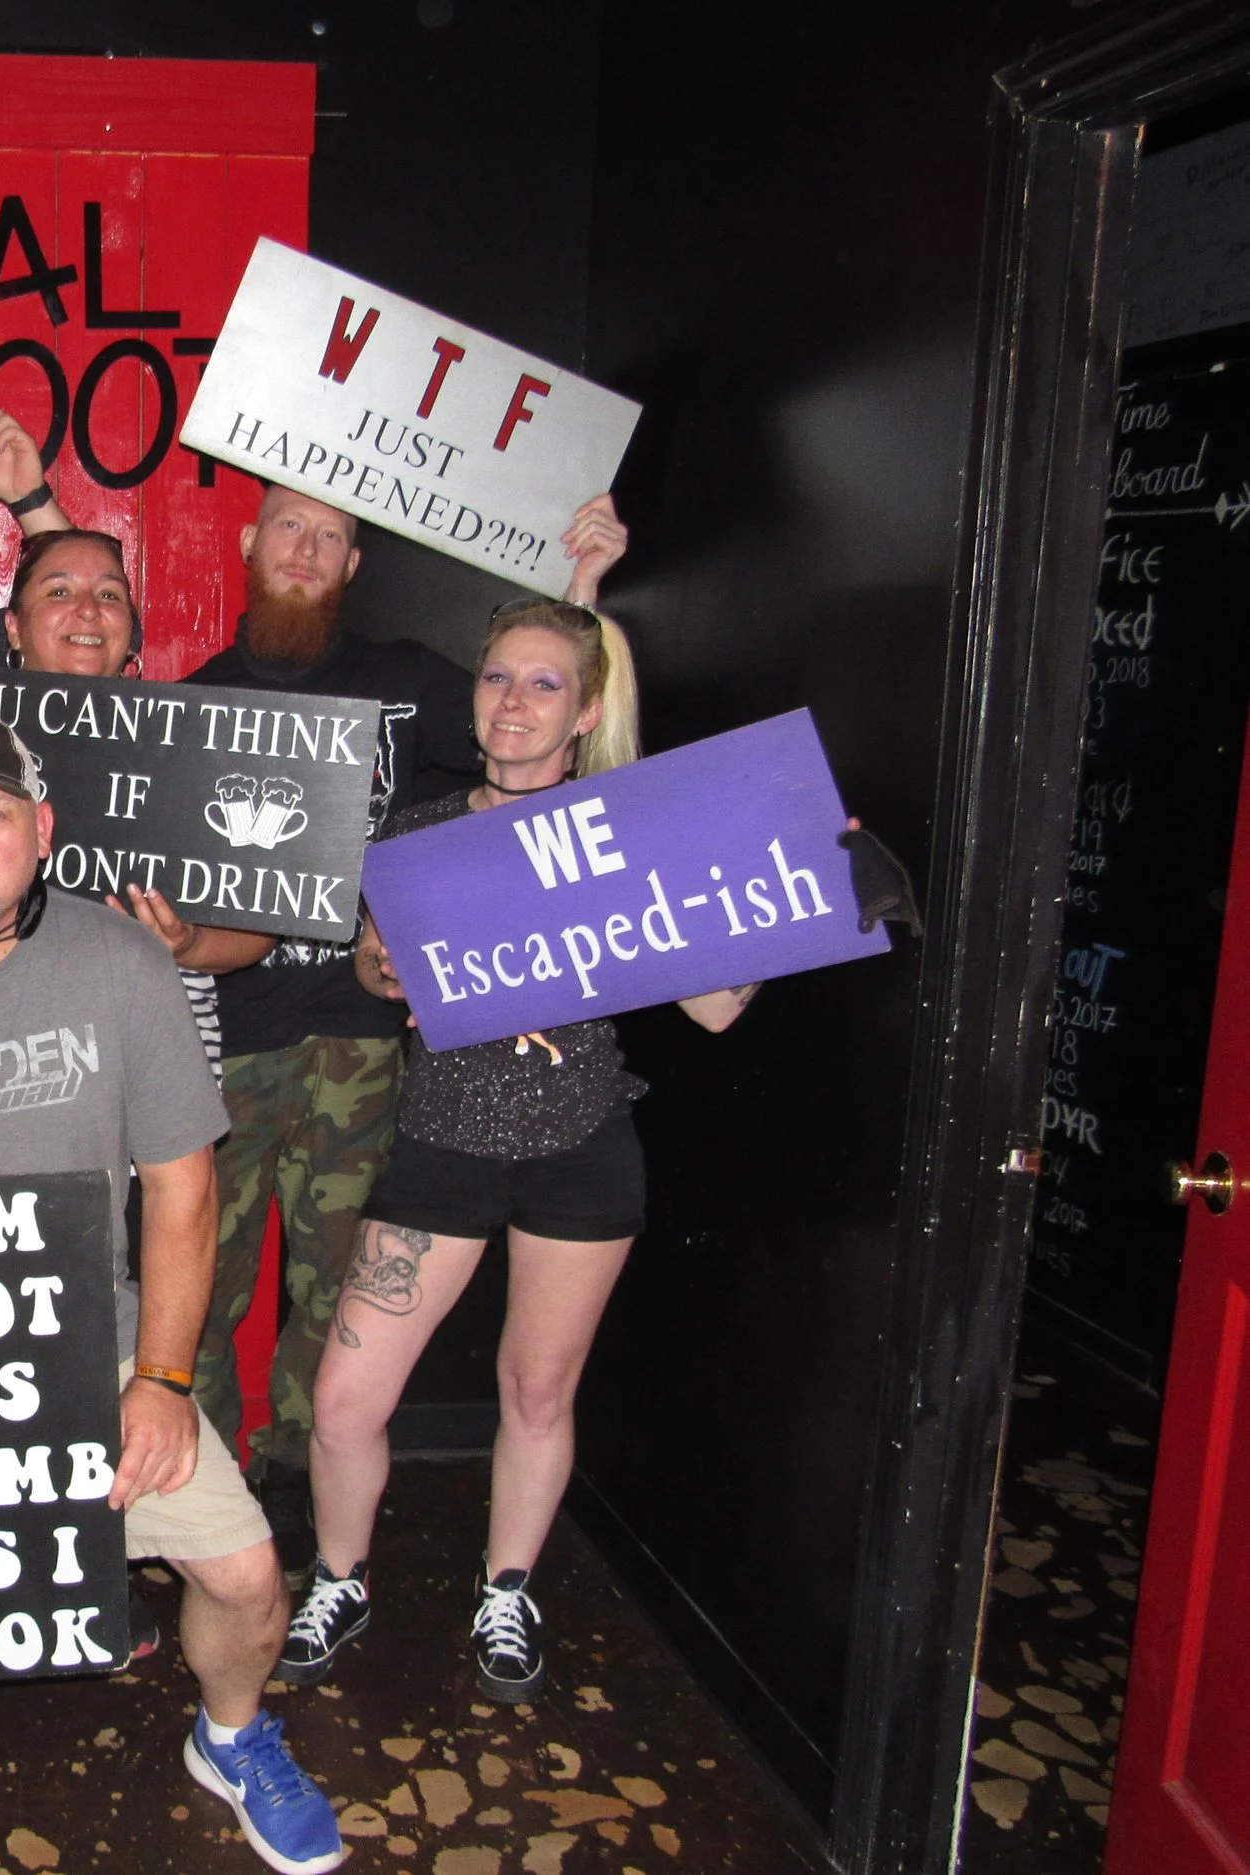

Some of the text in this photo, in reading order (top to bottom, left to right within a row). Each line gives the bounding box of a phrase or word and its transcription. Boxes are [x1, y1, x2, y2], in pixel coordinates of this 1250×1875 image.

[347, 409, 464, 480] JUST
[225, 412, 547, 572] HAPPENED?!?!
[38, 689, 185, 747] CAN'T
[199, 704, 363, 767] THINK
[104, 772, 151, 820] IF
[512, 796, 627, 890] WE
[43, 843, 345, 924] ON'T DRINK
[421, 838, 833, 1004] Escaped-ish
[51, 1526, 84, 1585] I
